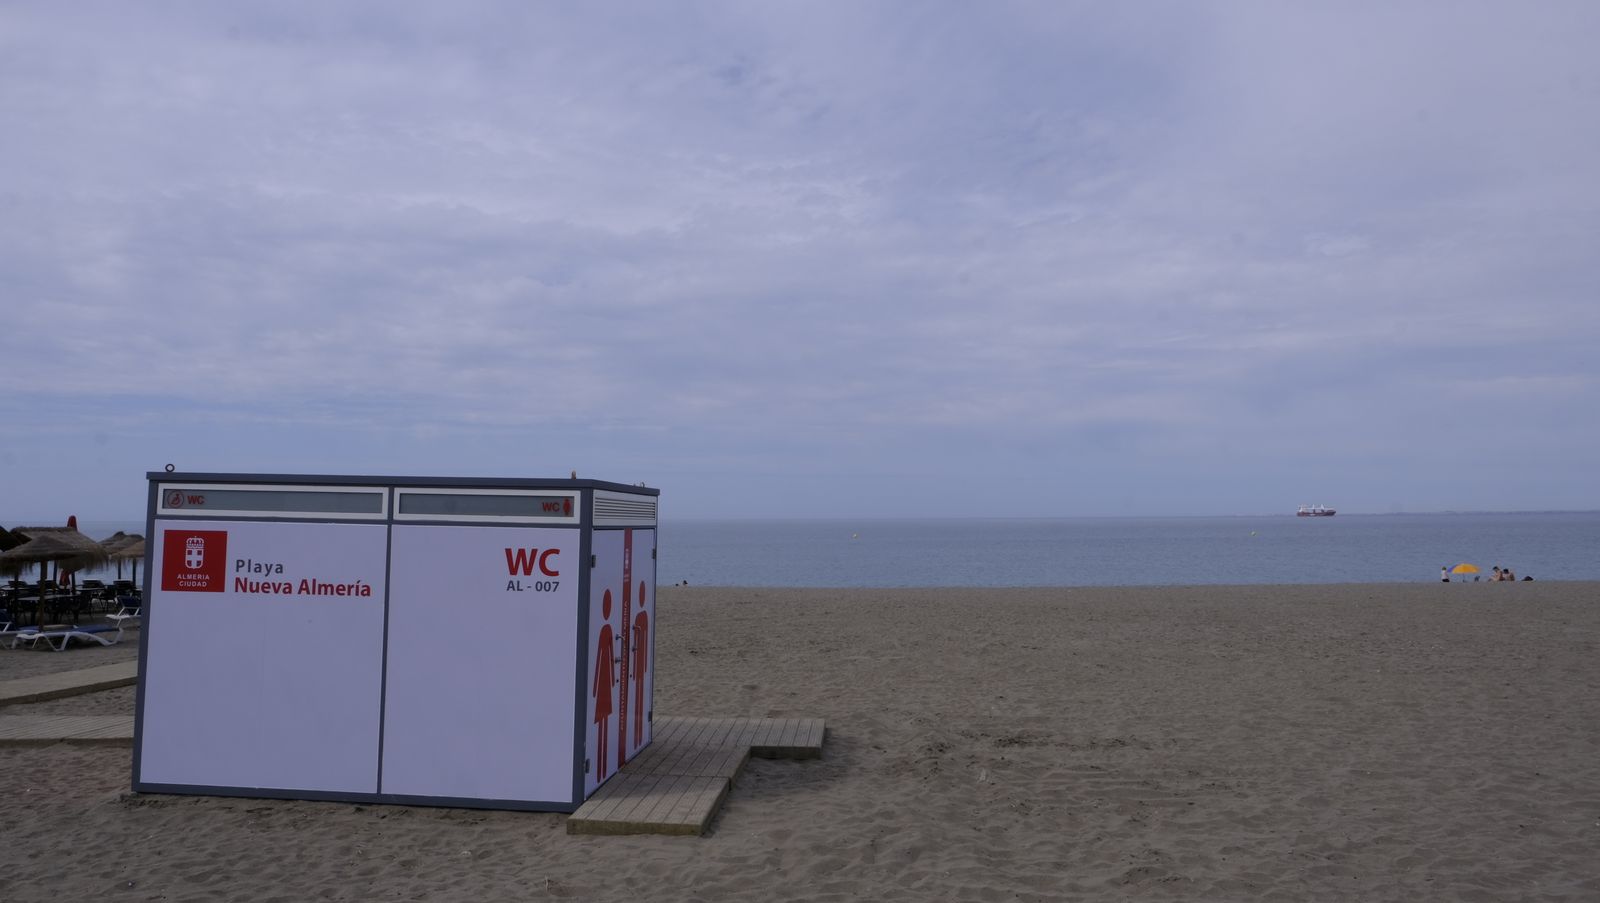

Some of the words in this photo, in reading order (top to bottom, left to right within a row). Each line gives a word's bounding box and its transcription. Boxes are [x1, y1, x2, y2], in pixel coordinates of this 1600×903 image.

[187, 495, 205, 505] WC
[542, 502, 560, 512] WC
[235, 559, 284, 577] Playa
[505, 548, 560, 577] WC
[234, 577, 293, 595] Nueva
[297, 580, 371, 597] Almería
[506, 580, 524, 592] AL
[535, 581, 560, 592] 007
